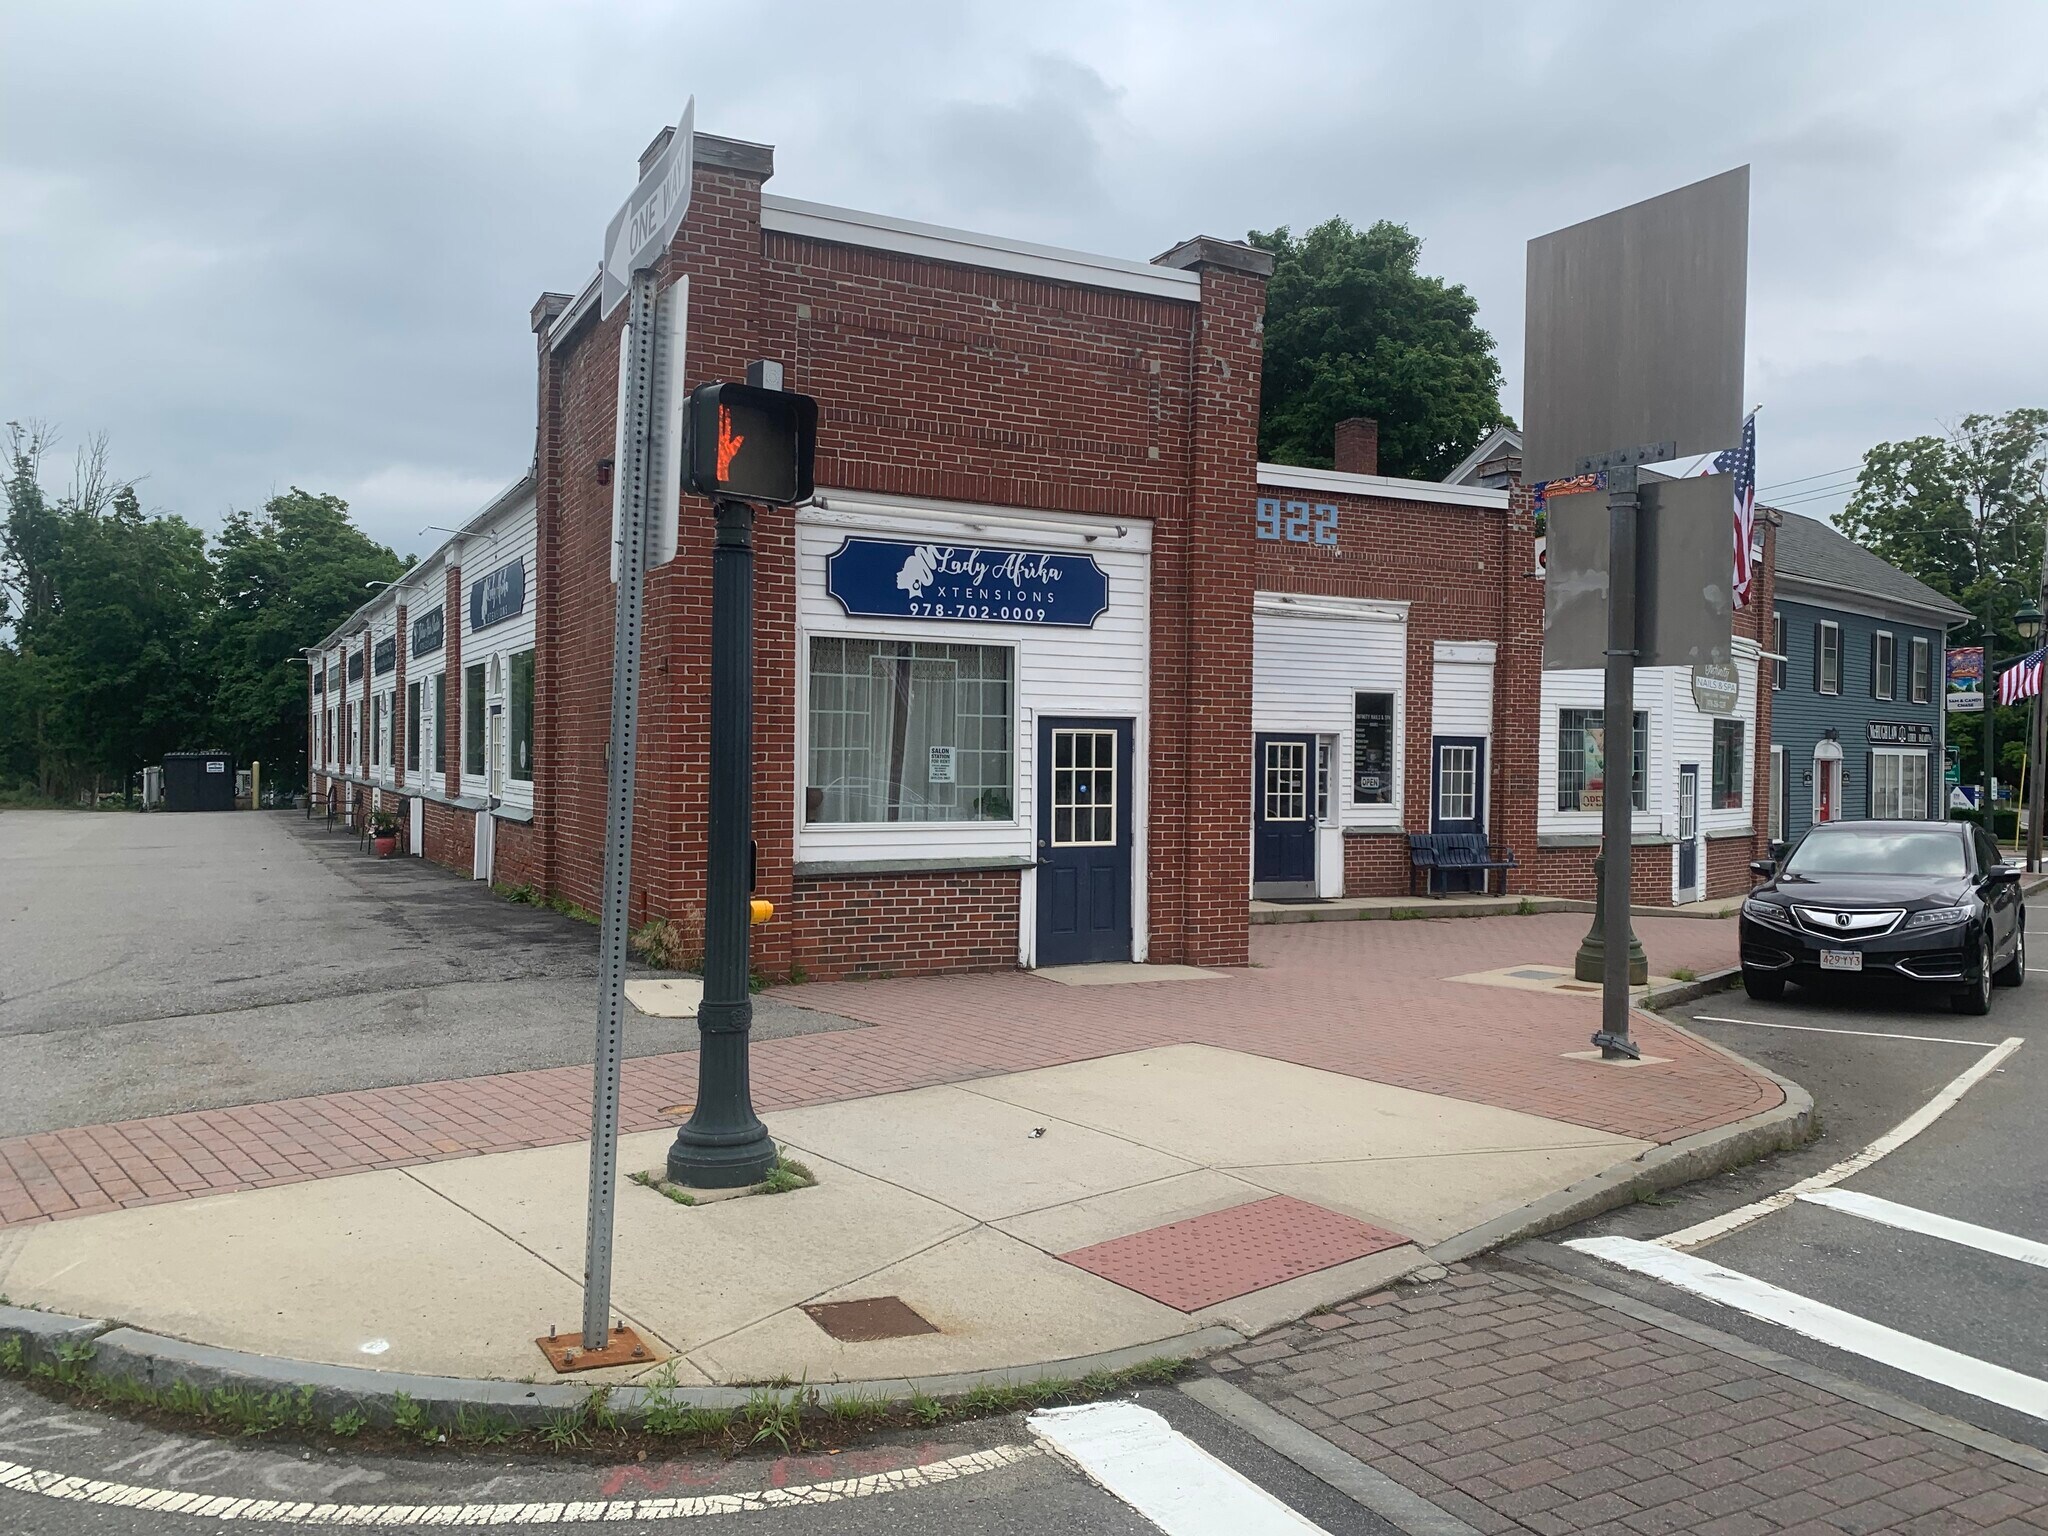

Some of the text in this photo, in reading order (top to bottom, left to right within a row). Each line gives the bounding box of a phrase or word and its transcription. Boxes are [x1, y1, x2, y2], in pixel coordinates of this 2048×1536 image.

[629, 146, 686, 256] ONE WAY
[937, 548, 1063, 588] Lady Afrika
[938, 586, 1055, 603] XTENSIONS
[909, 602, 1047, 622] 978-702-0009
[1697, 677, 1717, 689] NAILS
[1723, 682, 1736, 692] SPA
[1362, 778, 1378, 787] OPEN
[1583, 795, 1603, 807] OPE
